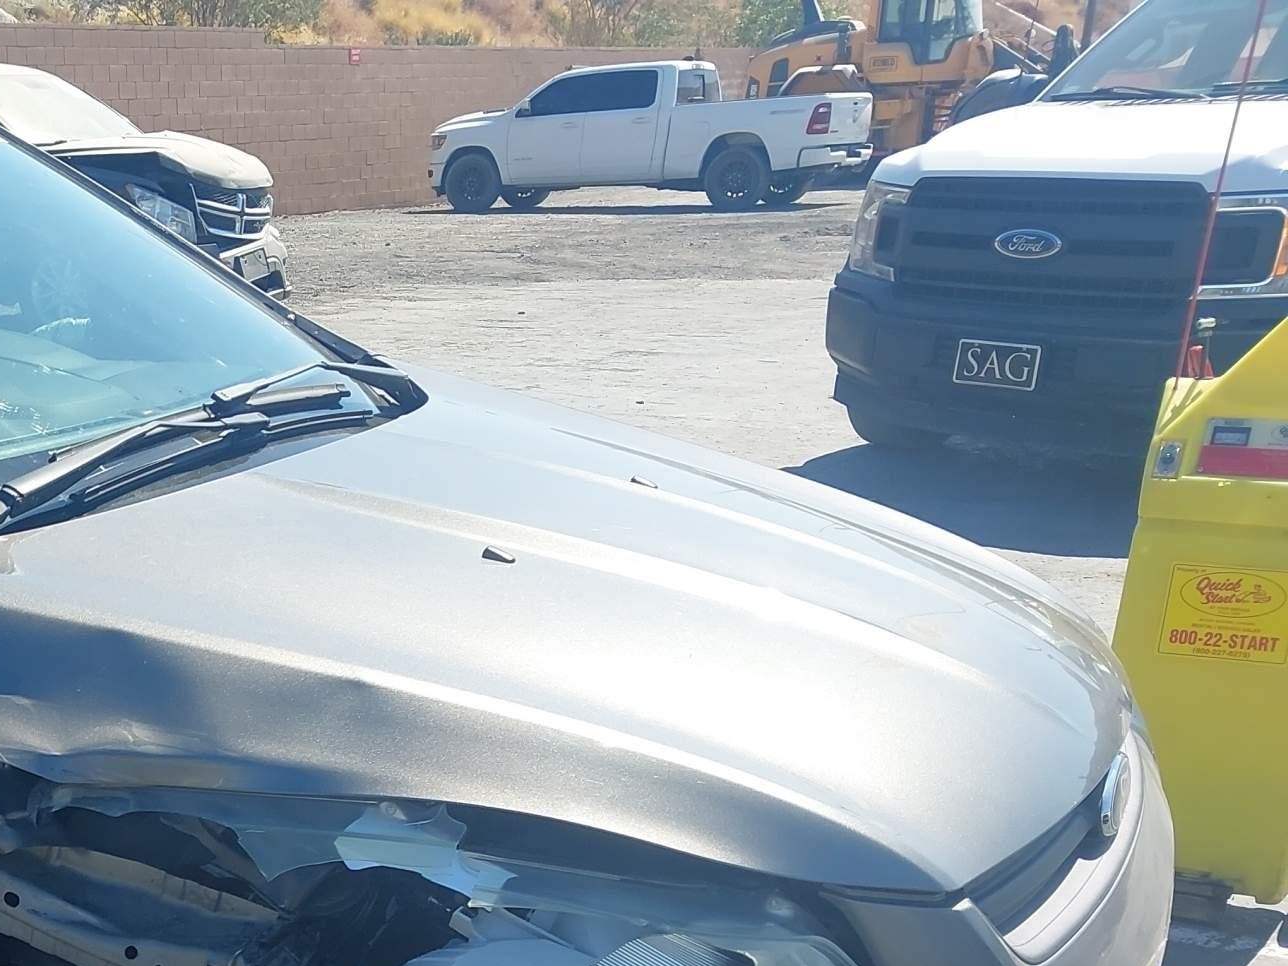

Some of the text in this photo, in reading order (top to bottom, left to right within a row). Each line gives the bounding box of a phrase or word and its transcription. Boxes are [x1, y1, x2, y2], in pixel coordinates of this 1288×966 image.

[1008, 234, 1045, 252] Ford
[963, 347, 1031, 382] SAG
[1196, 576, 1243, 595] Quick
[1200, 592, 1236, 605] Start
[1169, 628, 1280, 653] 800-22-START
